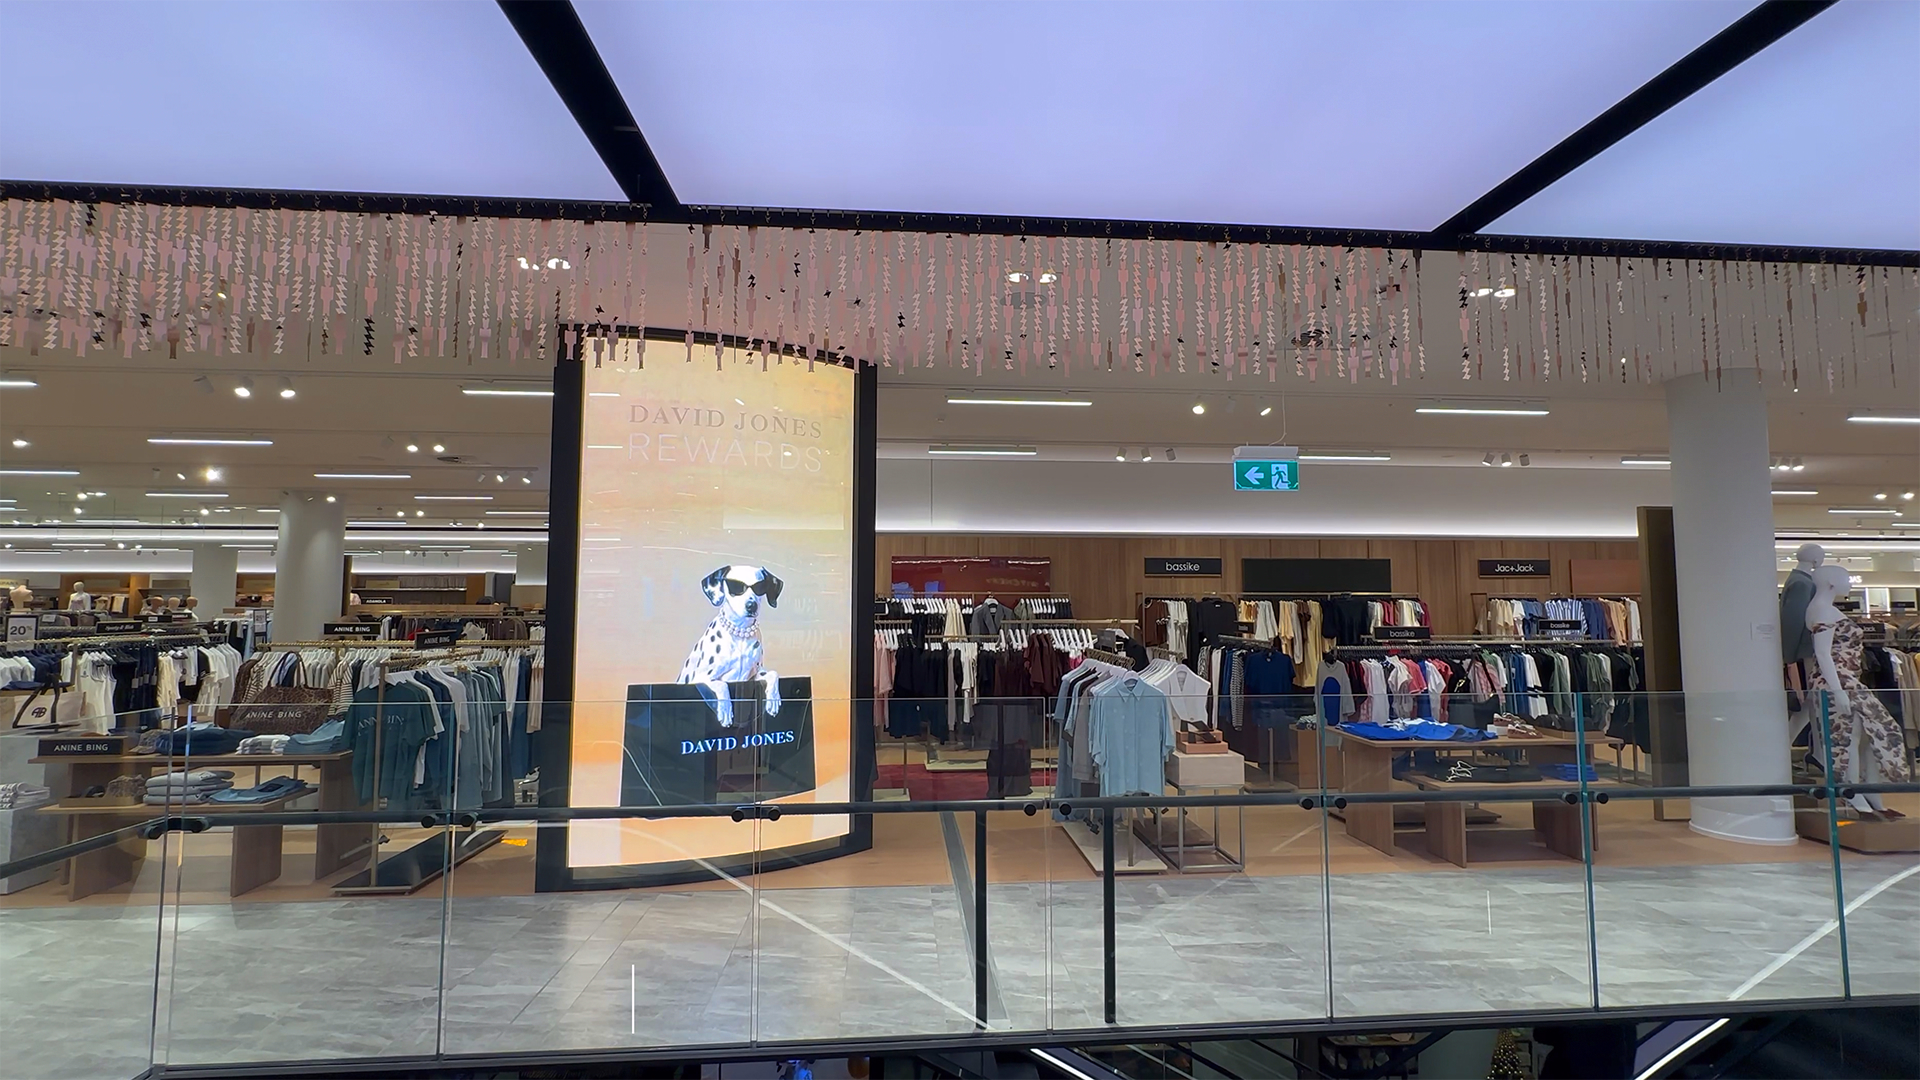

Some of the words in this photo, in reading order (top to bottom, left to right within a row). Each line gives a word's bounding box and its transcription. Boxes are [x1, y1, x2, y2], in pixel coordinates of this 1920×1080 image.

[629, 404, 725, 428] DAVID
[734, 411, 822, 439] JONES
[628, 432, 823, 473] REWARDS
[1165, 561, 1200, 571] bassike
[1494, 563, 1535, 573] Jac+Jack
[424, 637, 439, 645] ANINE
[439, 636, 451, 644] BING
[245, 711, 273, 719] ANINE
[277, 711, 302, 719] BING
[54, 744, 82, 752] ANINE
[86, 743, 109, 751] BING
[681, 736, 737, 755] DAVID
[741, 730, 795, 749] JONES
